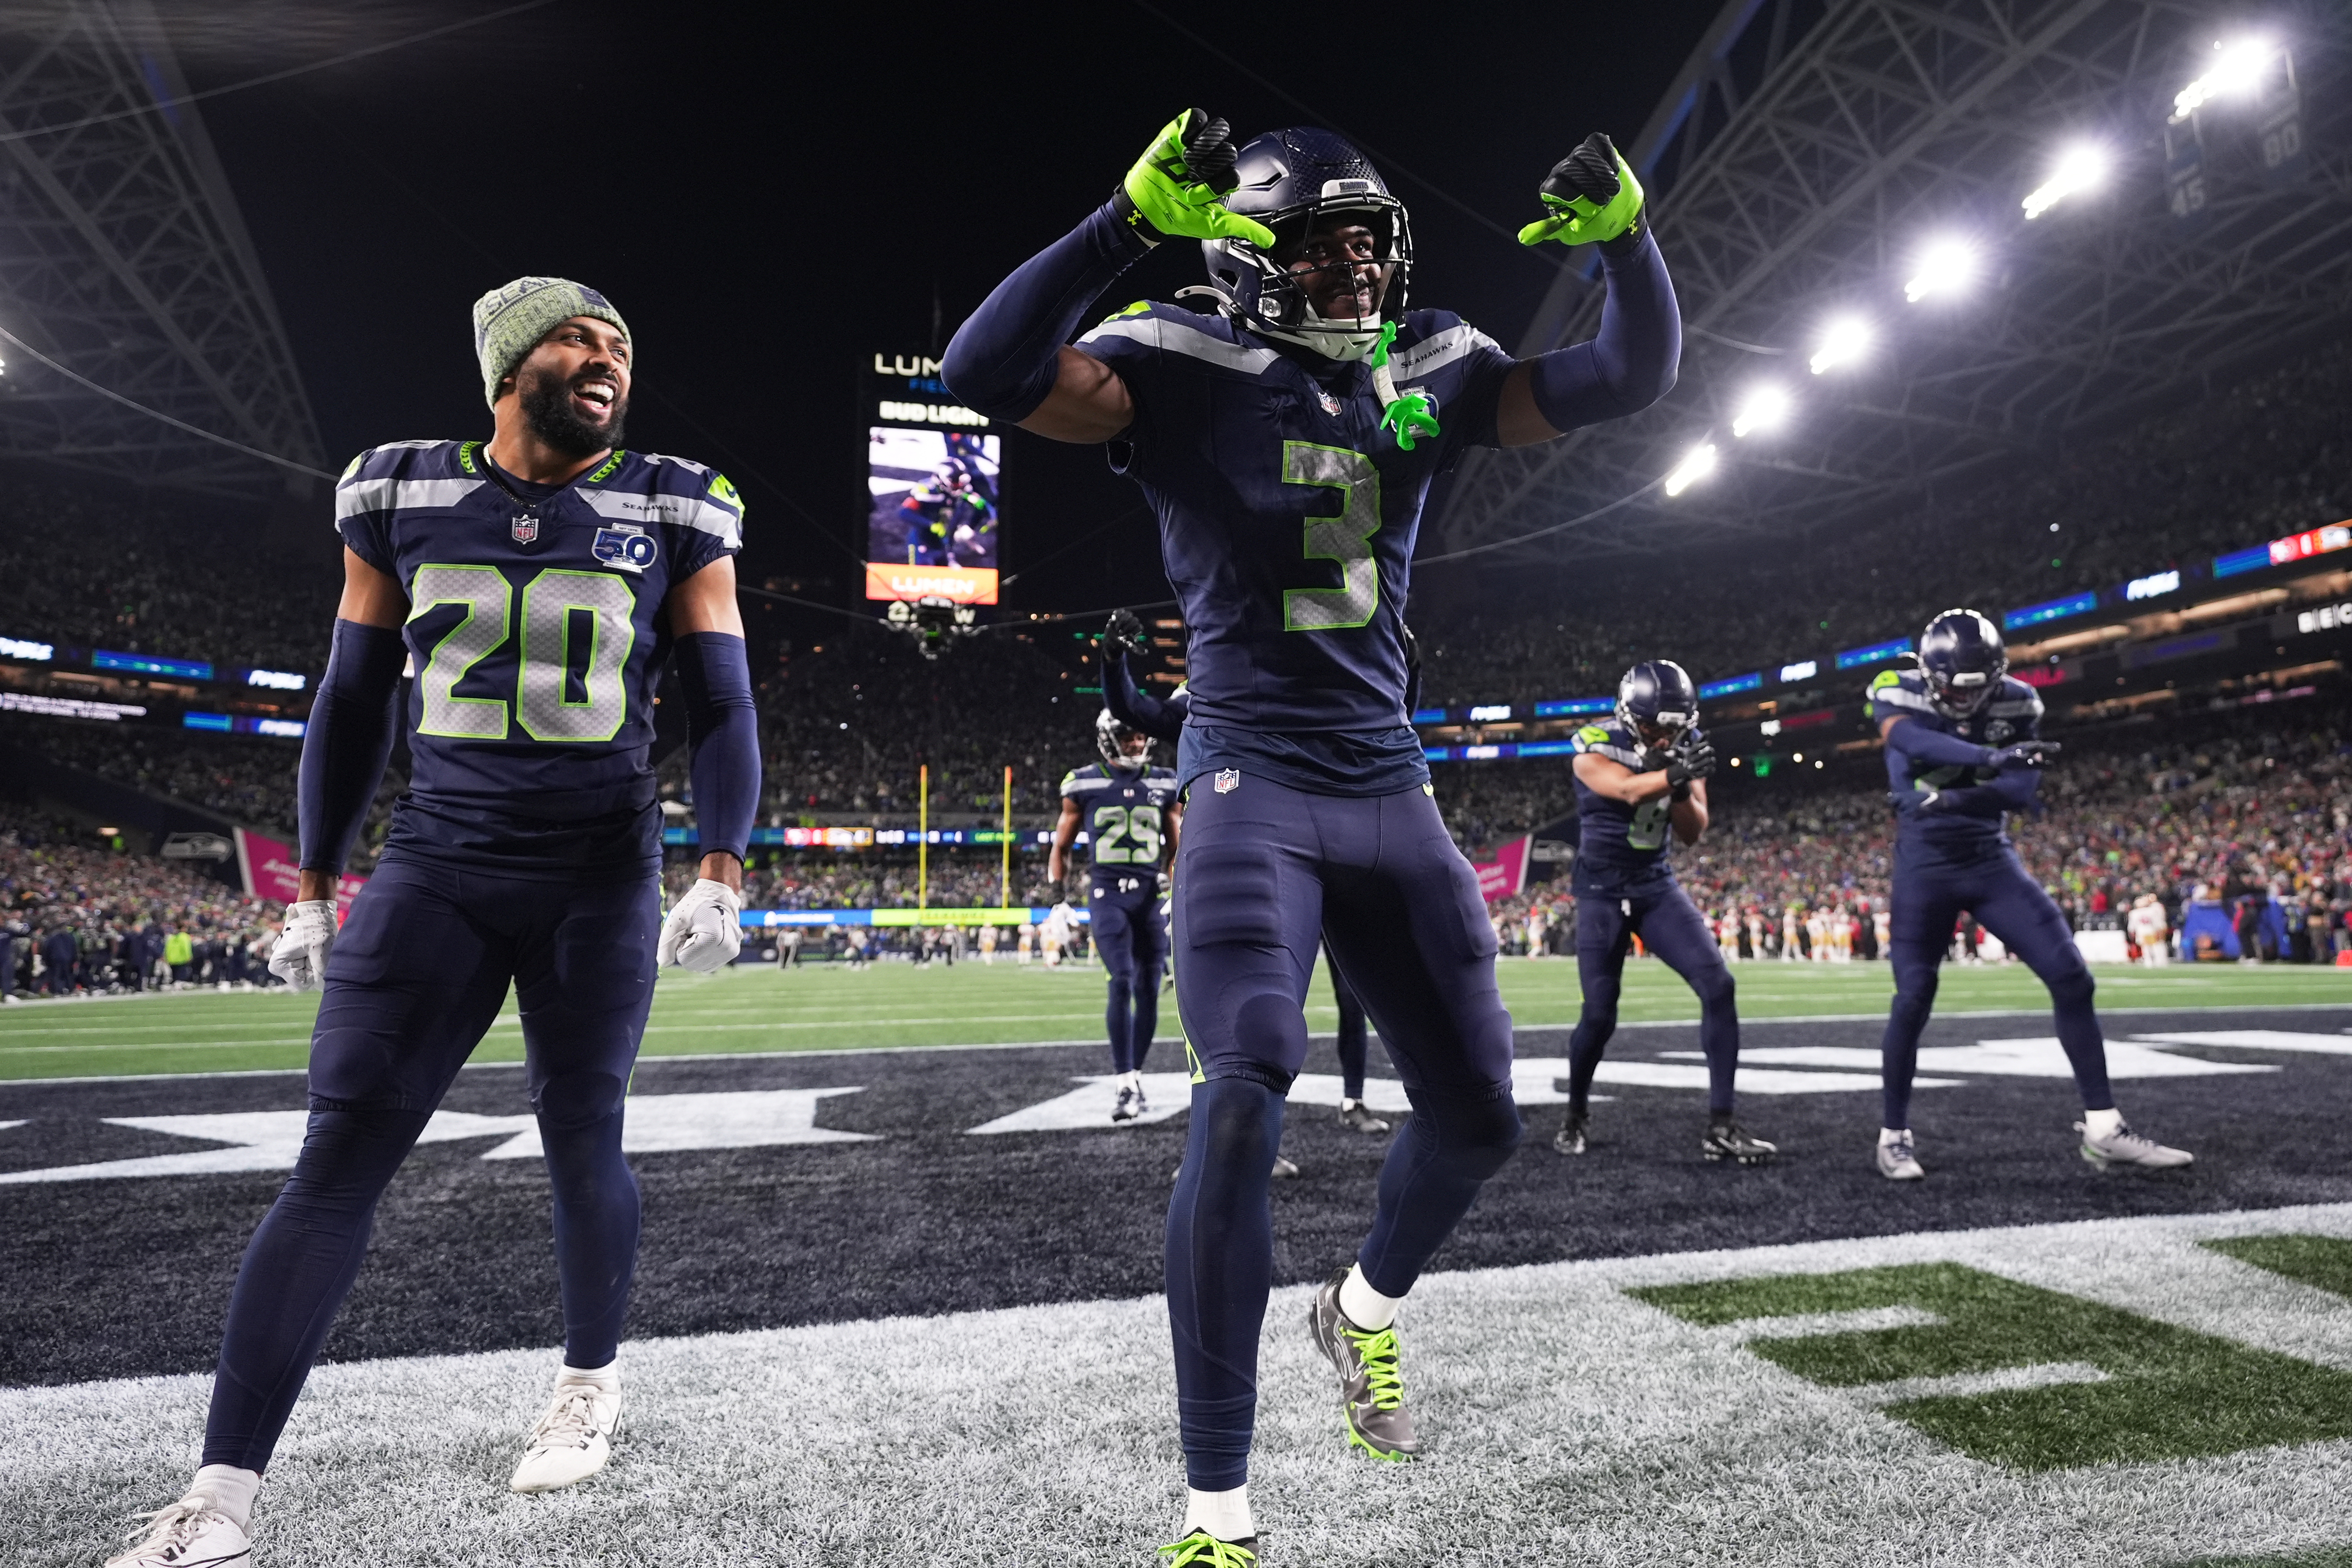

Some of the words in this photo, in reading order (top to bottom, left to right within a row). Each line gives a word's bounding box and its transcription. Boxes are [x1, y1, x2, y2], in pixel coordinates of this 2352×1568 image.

[875, 353, 944, 377] LUM
[1401, 341, 1453, 368] SEAHAWKS
[1324, 401, 1339, 411] NFL
[622, 502, 679, 512] SEAHAWKS
[517, 527, 534, 539] NFL
[1282, 440, 1381, 632] 3
[593, 528, 657, 568] 50
[892, 576, 976, 594] LUMEN
[405, 563, 636, 742] 20
[1219, 779, 1234, 788] NFL
[1094, 805, 1161, 863] 29
